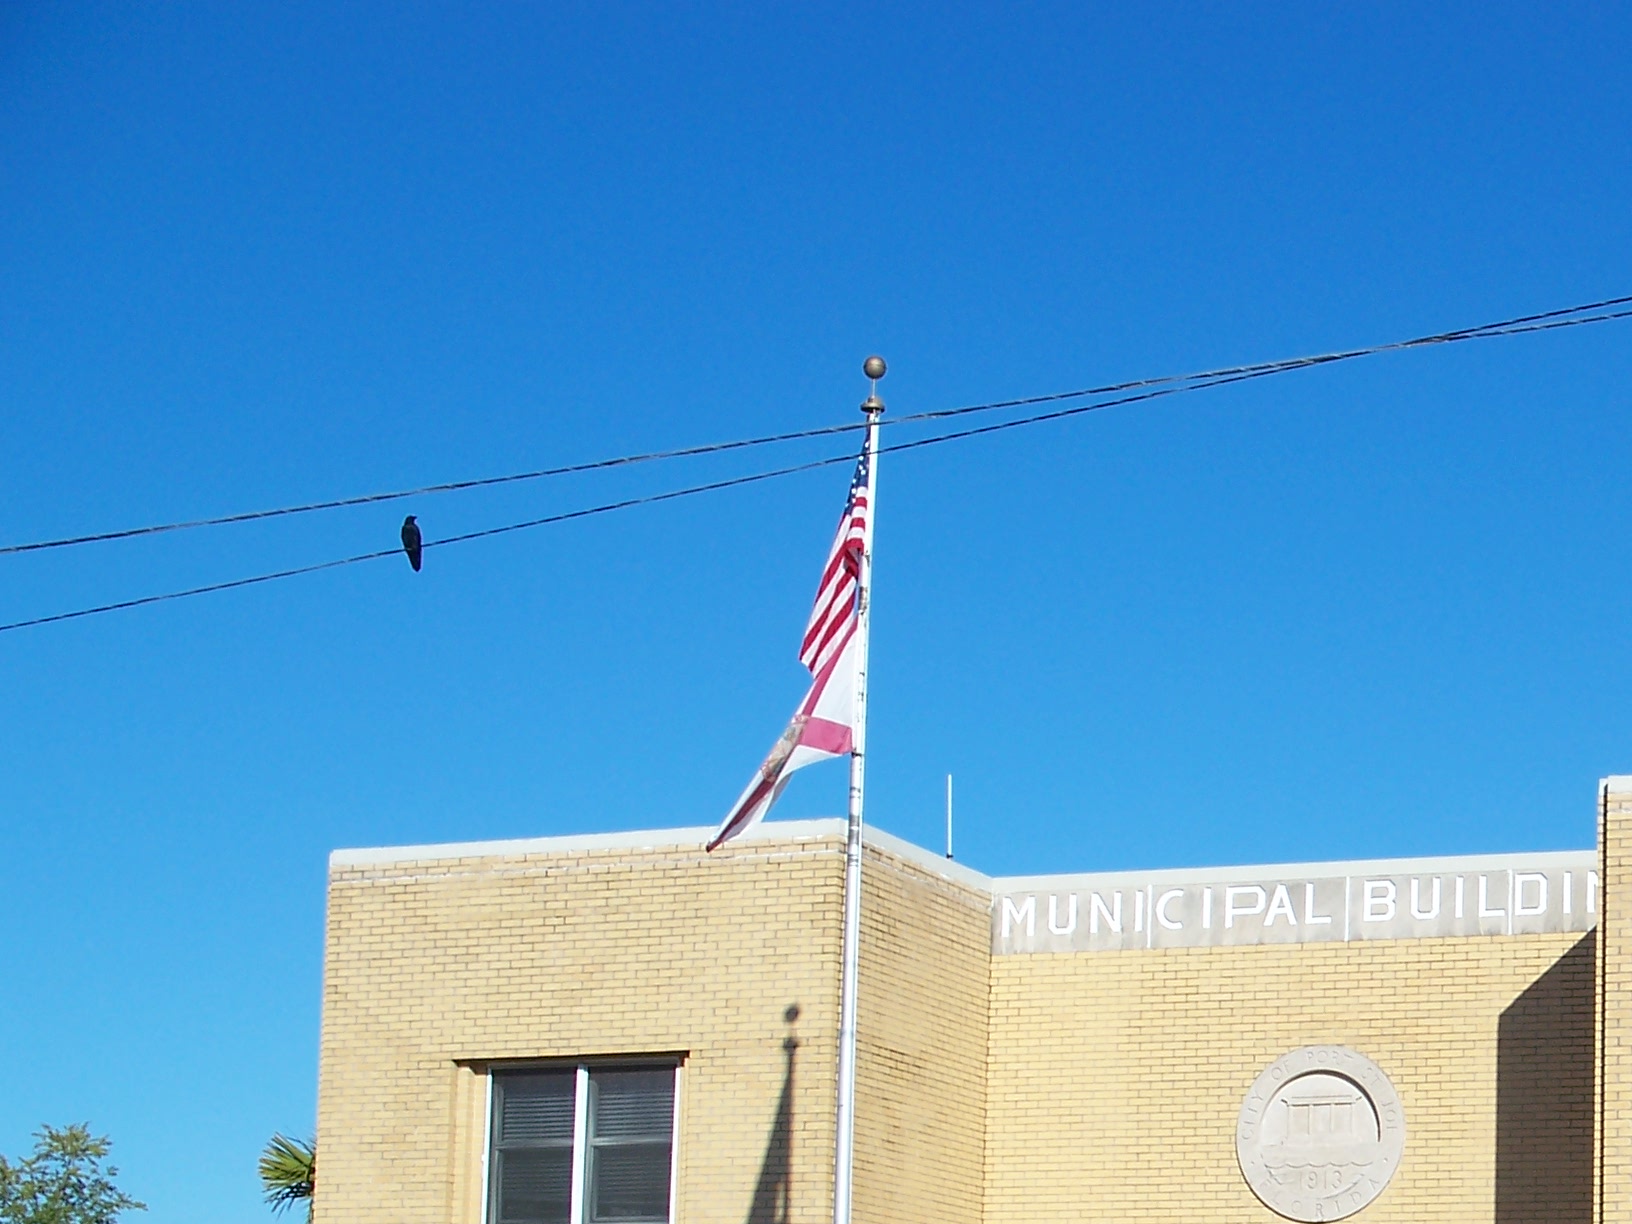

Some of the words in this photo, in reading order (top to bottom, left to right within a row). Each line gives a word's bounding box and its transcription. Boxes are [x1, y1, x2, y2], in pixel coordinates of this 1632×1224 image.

[1001, 883, 1331, 938] MUNICIPAL
[1241, 1092, 1264, 1141] CITY
[1270, 1059, 1291, 1081] OF
[1305, 1049, 1354, 1064] PORT
[1259, 1177, 1380, 1218] FLORIDA
[1299, 1169, 1343, 1191] 1913
